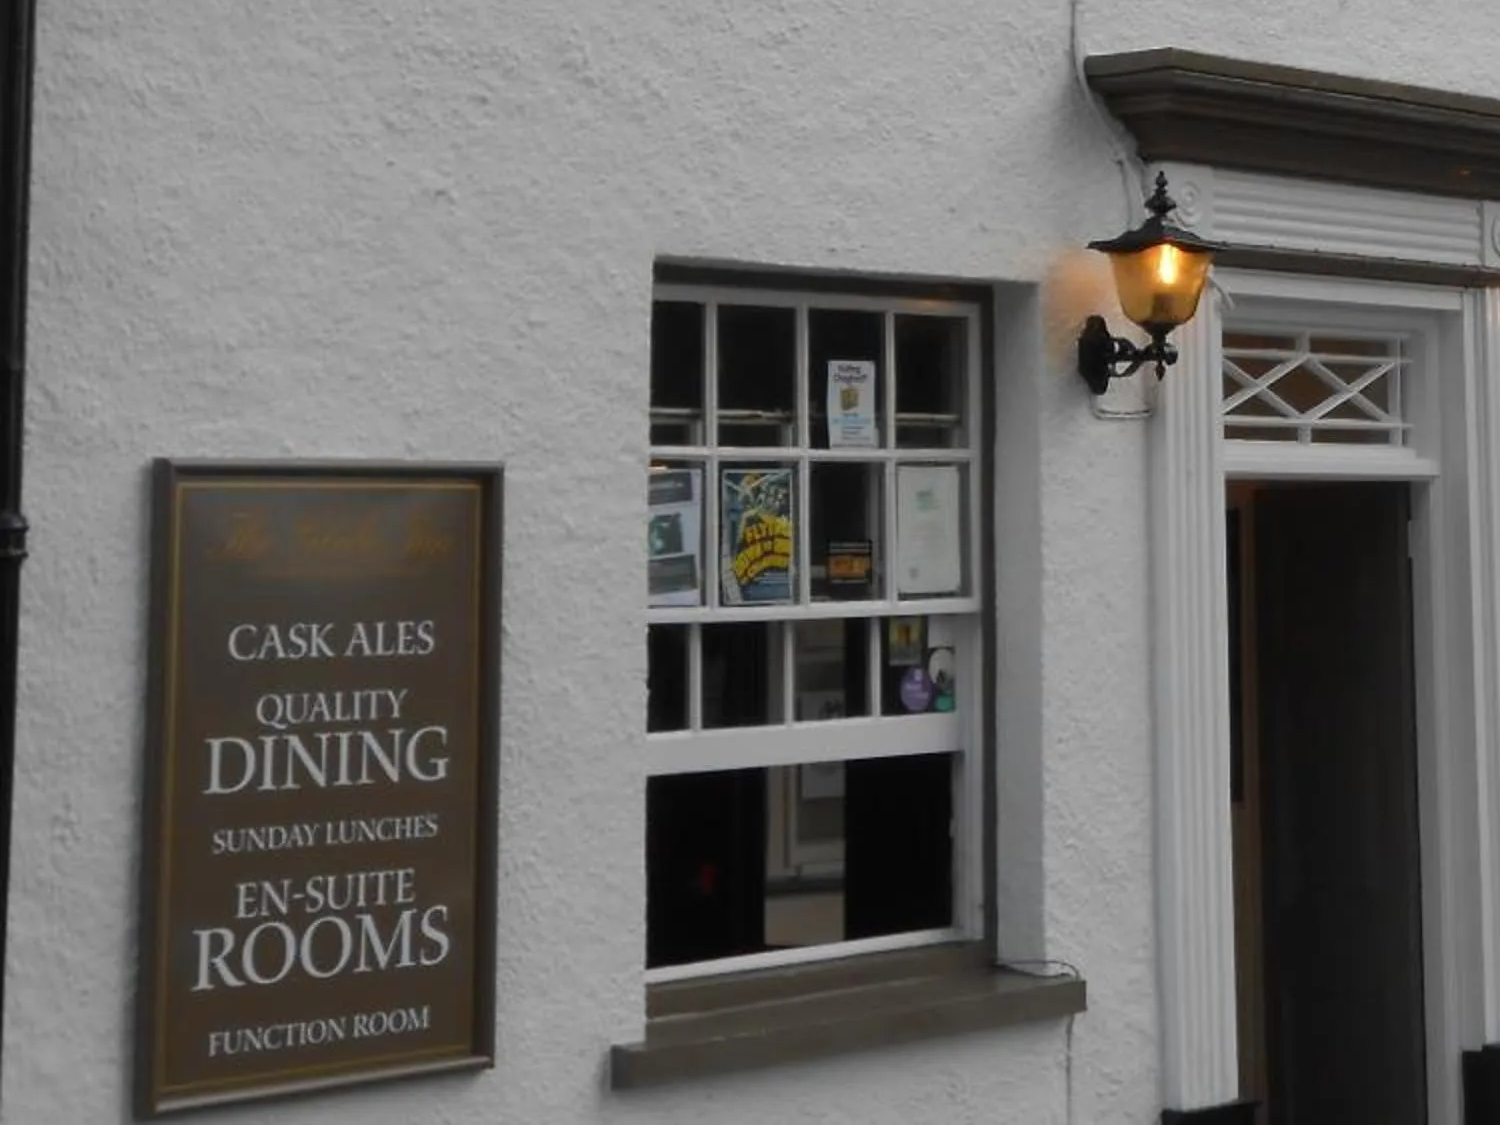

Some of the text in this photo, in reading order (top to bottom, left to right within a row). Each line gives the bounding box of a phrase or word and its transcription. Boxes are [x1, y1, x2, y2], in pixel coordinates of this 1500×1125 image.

[228, 620, 435, 661] CASK ALES
[256, 689, 408, 727] QUALITY
[202, 725, 450, 795] DINING
[212, 815, 438, 855] SUNDAY LUNCHES
[235, 868, 415, 918] EN-SUITE
[192, 906, 450, 990] ROOMS
[208, 1006, 431, 1057] FUNCTION ROOM
